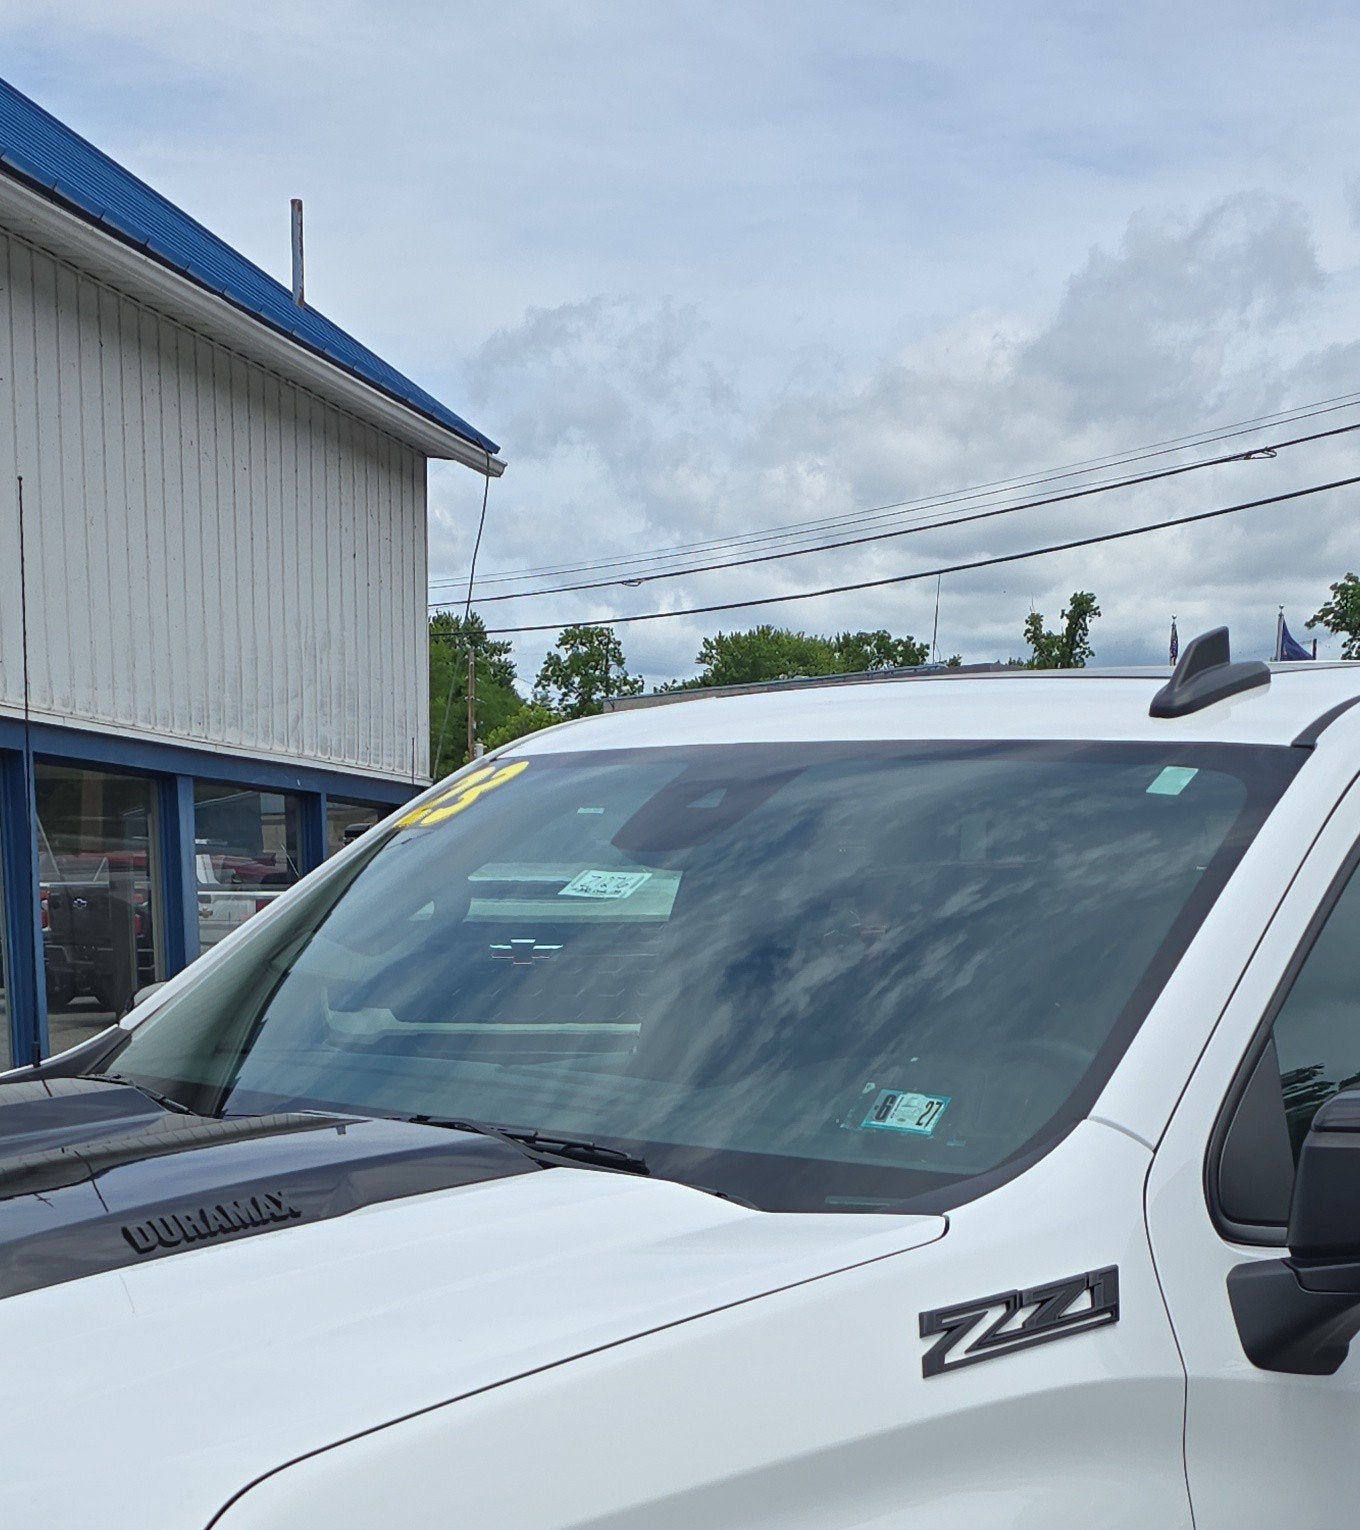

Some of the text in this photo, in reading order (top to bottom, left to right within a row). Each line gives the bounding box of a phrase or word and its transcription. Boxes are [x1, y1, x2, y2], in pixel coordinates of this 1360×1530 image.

[915, 1100, 944, 1129] 27
[121, 1191, 303, 1255] DURAMAX
[918, 1263, 1120, 1379] Z71
